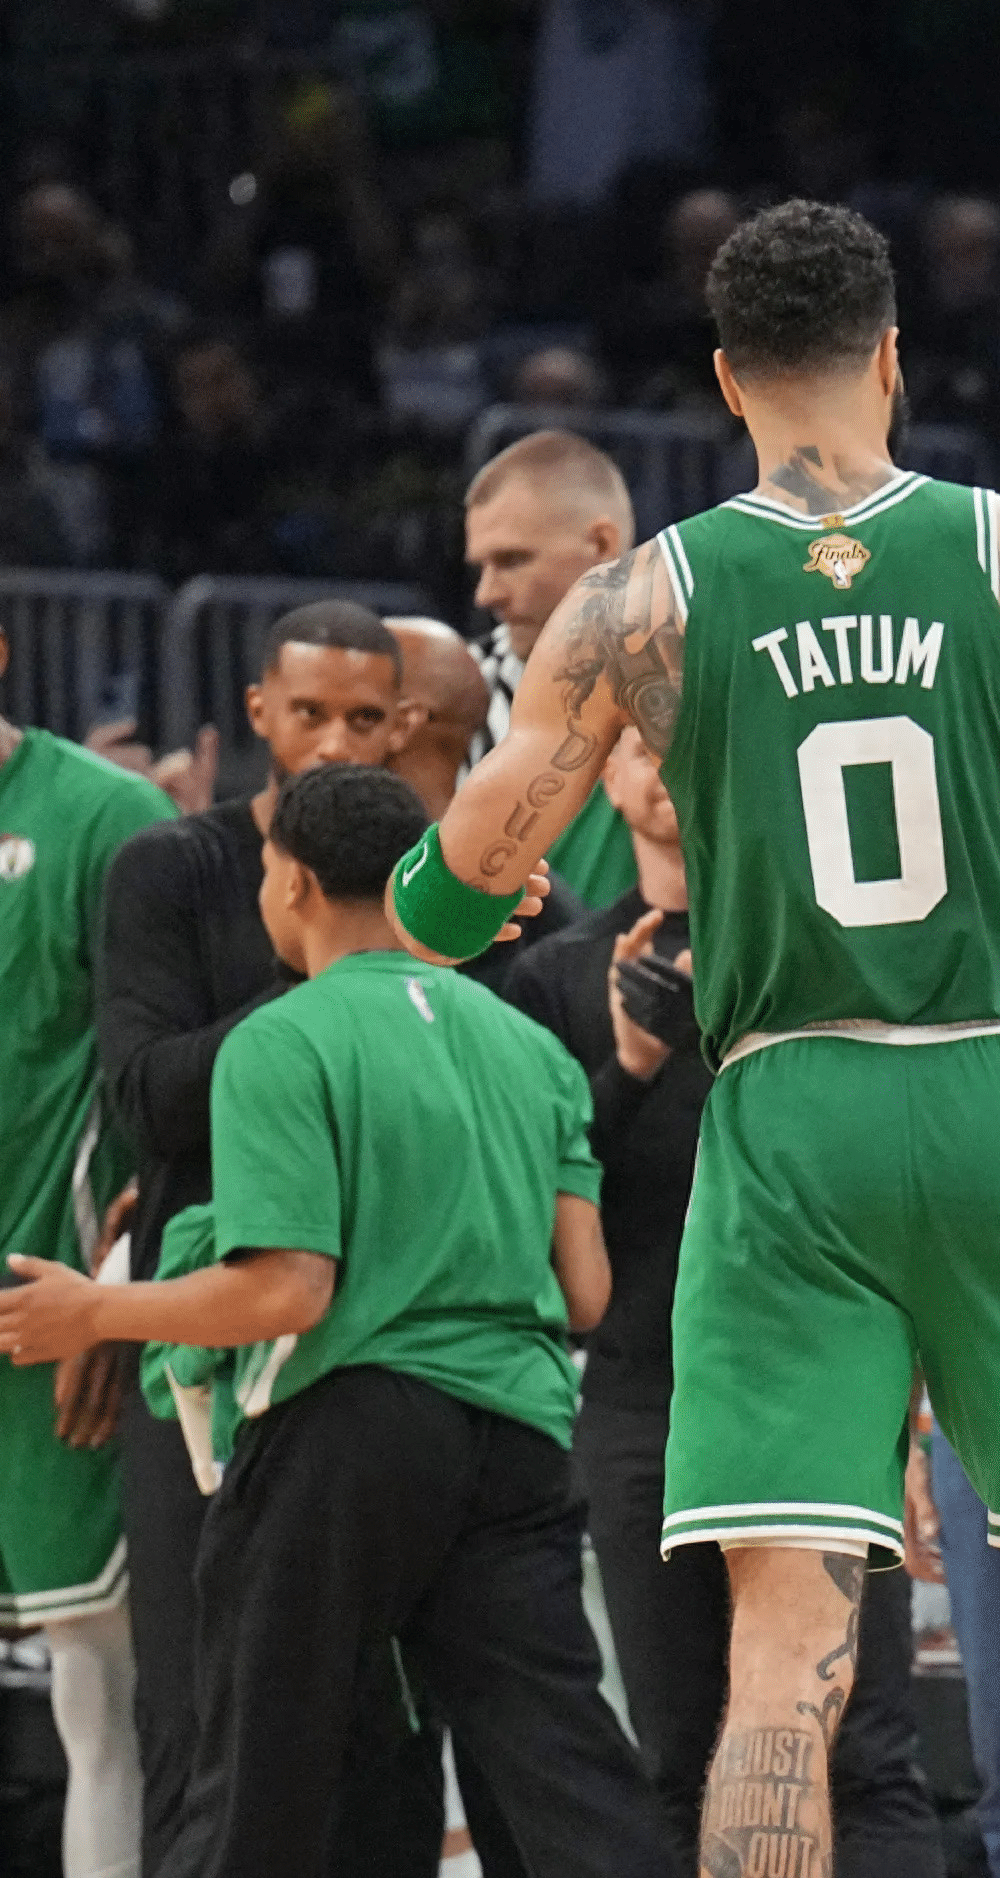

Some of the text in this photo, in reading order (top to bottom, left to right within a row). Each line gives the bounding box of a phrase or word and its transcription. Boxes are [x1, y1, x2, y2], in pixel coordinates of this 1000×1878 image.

[806, 543, 867, 568] Finals
[752, 614, 945, 698] TATUM
[797, 715, 947, 928] 0
[736, 1730, 813, 1778] JUST
